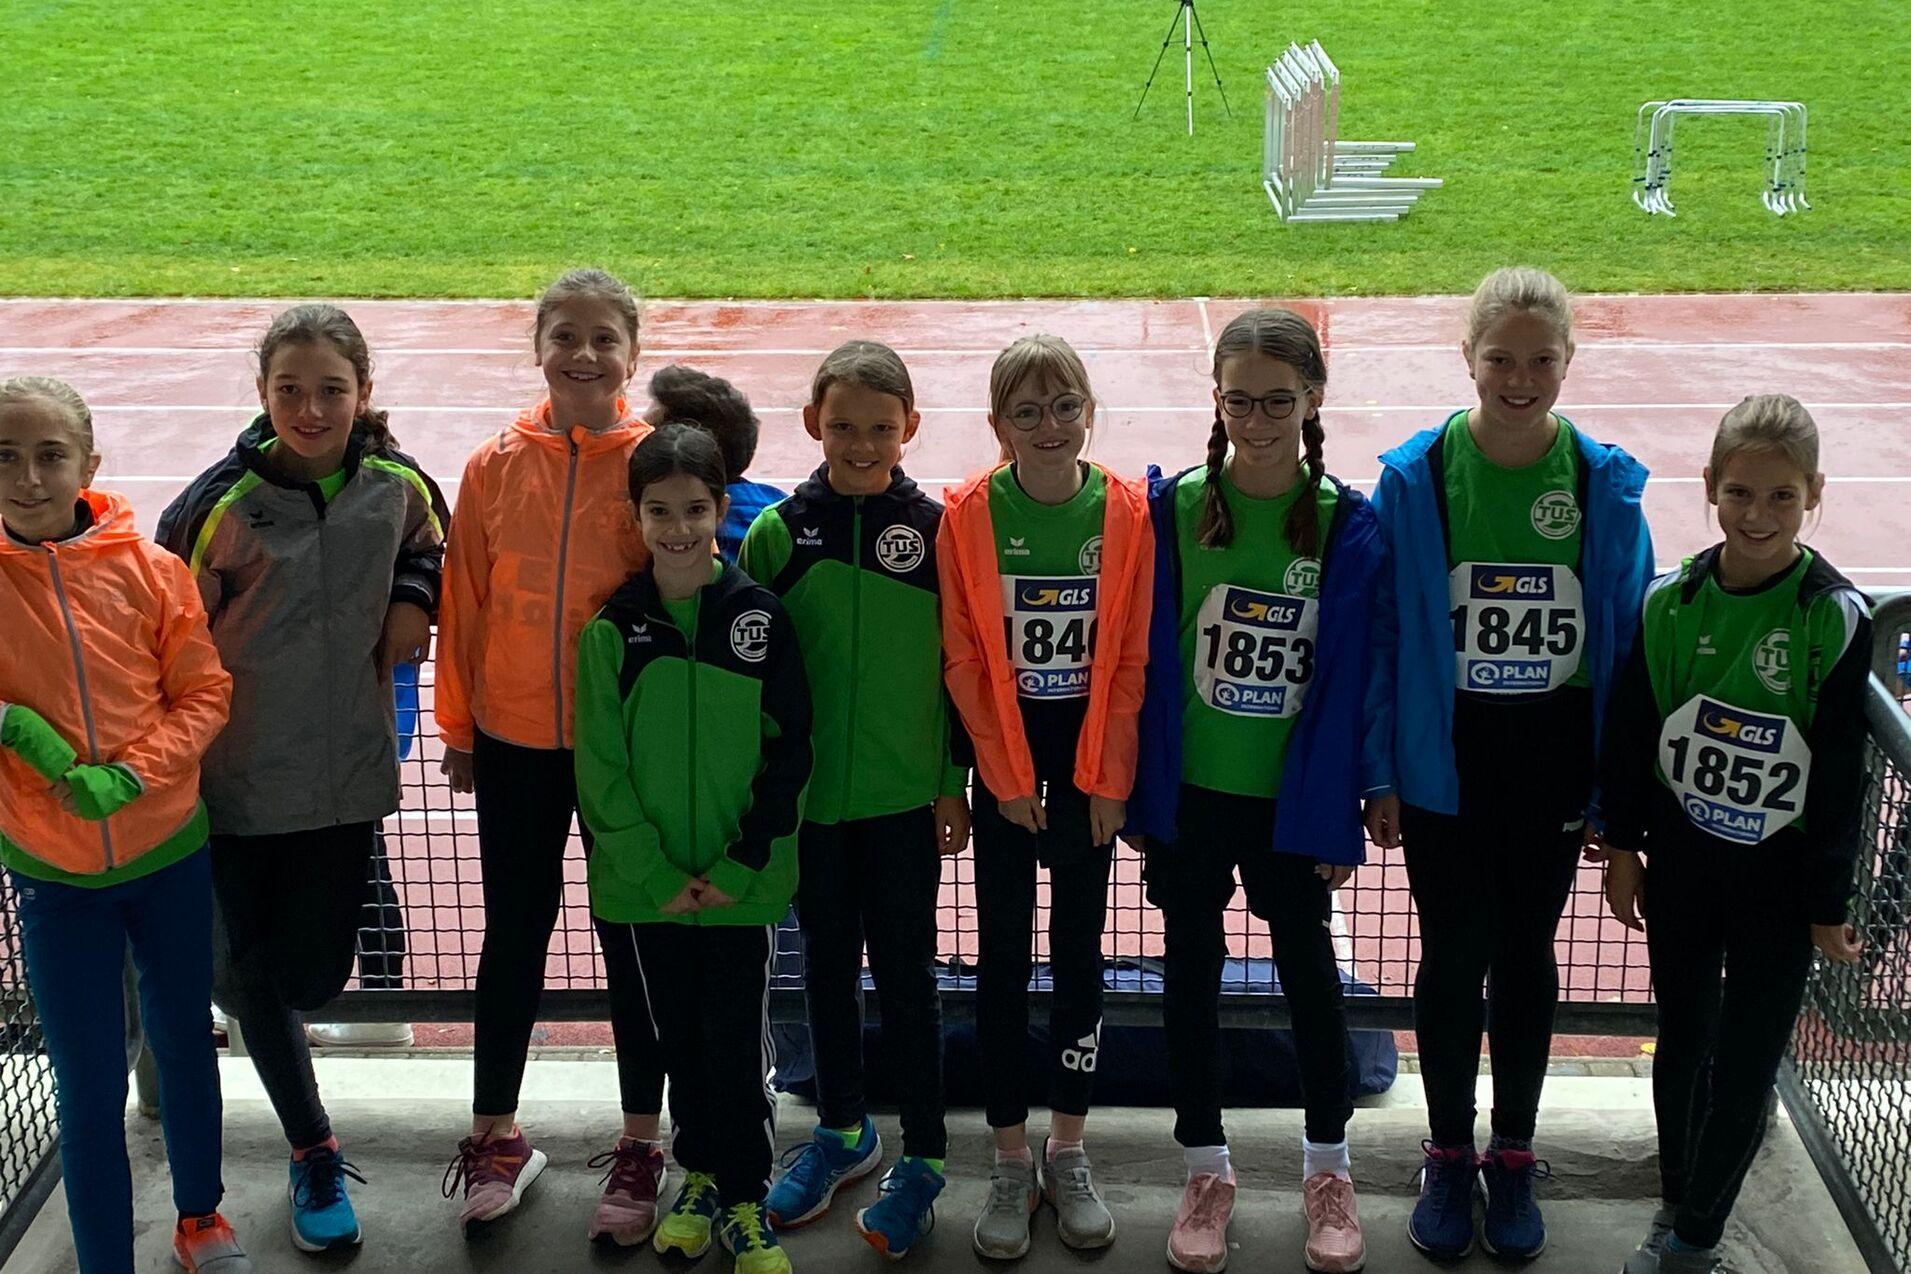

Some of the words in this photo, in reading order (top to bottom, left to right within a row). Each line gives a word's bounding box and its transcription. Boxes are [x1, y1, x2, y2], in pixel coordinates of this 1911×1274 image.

[796, 537, 823, 546] erima
[882, 540, 920, 554] TUS
[1516, 576, 1548, 594] GLS
[1059, 588, 1091, 606] GLS
[1266, 606, 1296, 623] GLS
[628, 634, 652, 643] erima
[1450, 605, 1578, 656] 1845
[1203, 623, 1316, 685] 1853
[1047, 671, 1088, 687] PLAN
[1503, 665, 1548, 680] PLAN
[1241, 689, 1283, 705] PLAN
[1738, 724, 1777, 745] GLS
[1667, 735, 1801, 812] 1852
[1712, 809, 1761, 832] PLAN
